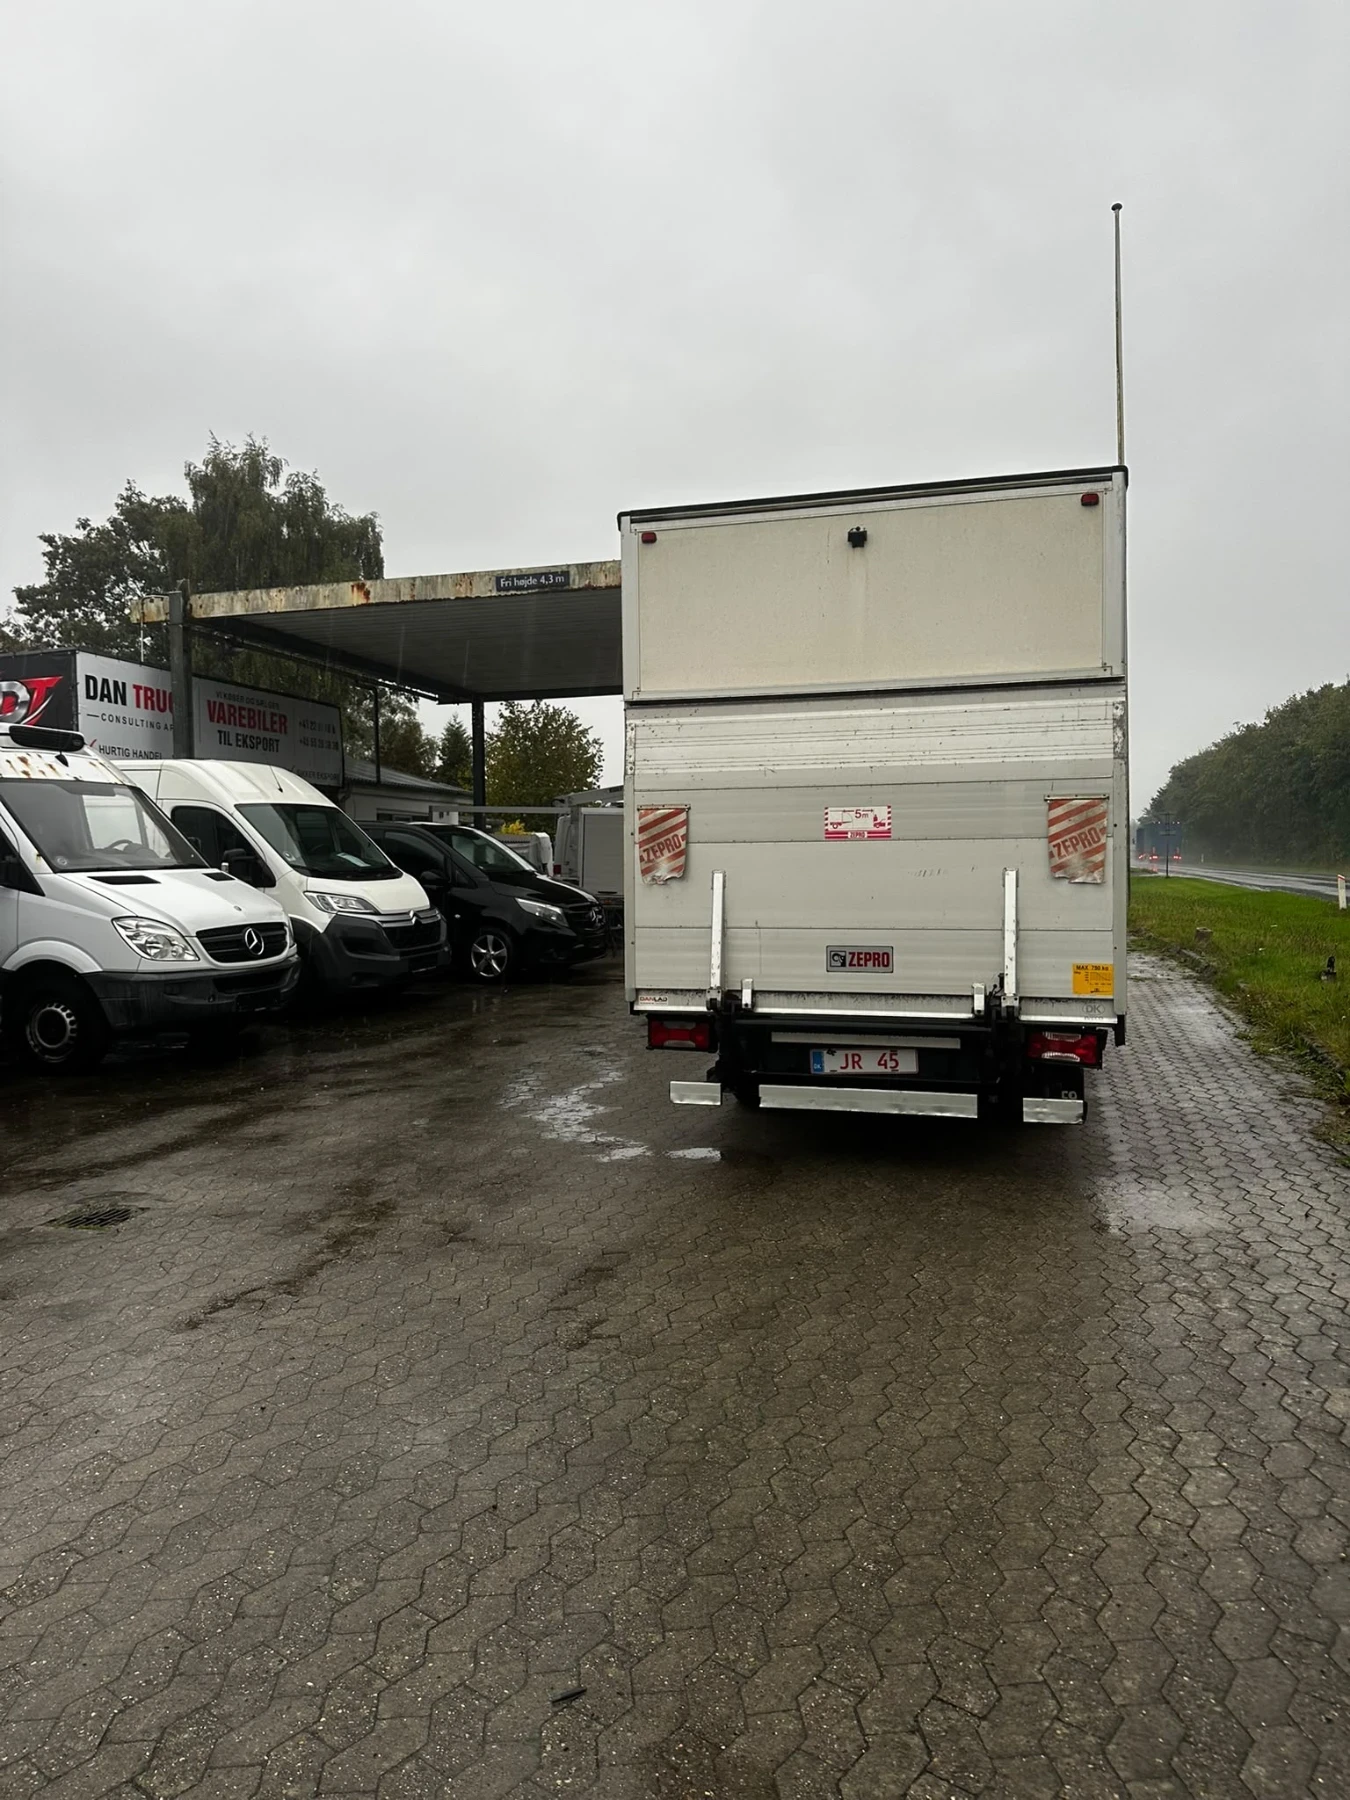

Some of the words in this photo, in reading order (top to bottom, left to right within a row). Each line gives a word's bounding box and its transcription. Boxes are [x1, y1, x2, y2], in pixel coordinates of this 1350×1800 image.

[500, 578, 512, 587] Fri
[514, 576, 538, 587] højde
[540, 574, 553, 584] 4,3
[85, 674, 127, 706] DAN
[101, 713, 161, 730] CONSULTING
[206, 700, 288, 735] VAREBILER
[217, 729, 233, 746] TIL
[235, 732, 280, 753] EKSPORT
[99, 745, 130, 757] HURTIG
[132, 749, 162, 760] HANDEL
[855, 809, 861, 819] 5
[643, 833, 682, 864] ZEPRO
[1052, 826, 1101, 860] ZEPRO
[848, 951, 890, 968] ZEPRO
[840, 1053, 863, 1070] JR
[877, 1052, 900, 1070] 45
